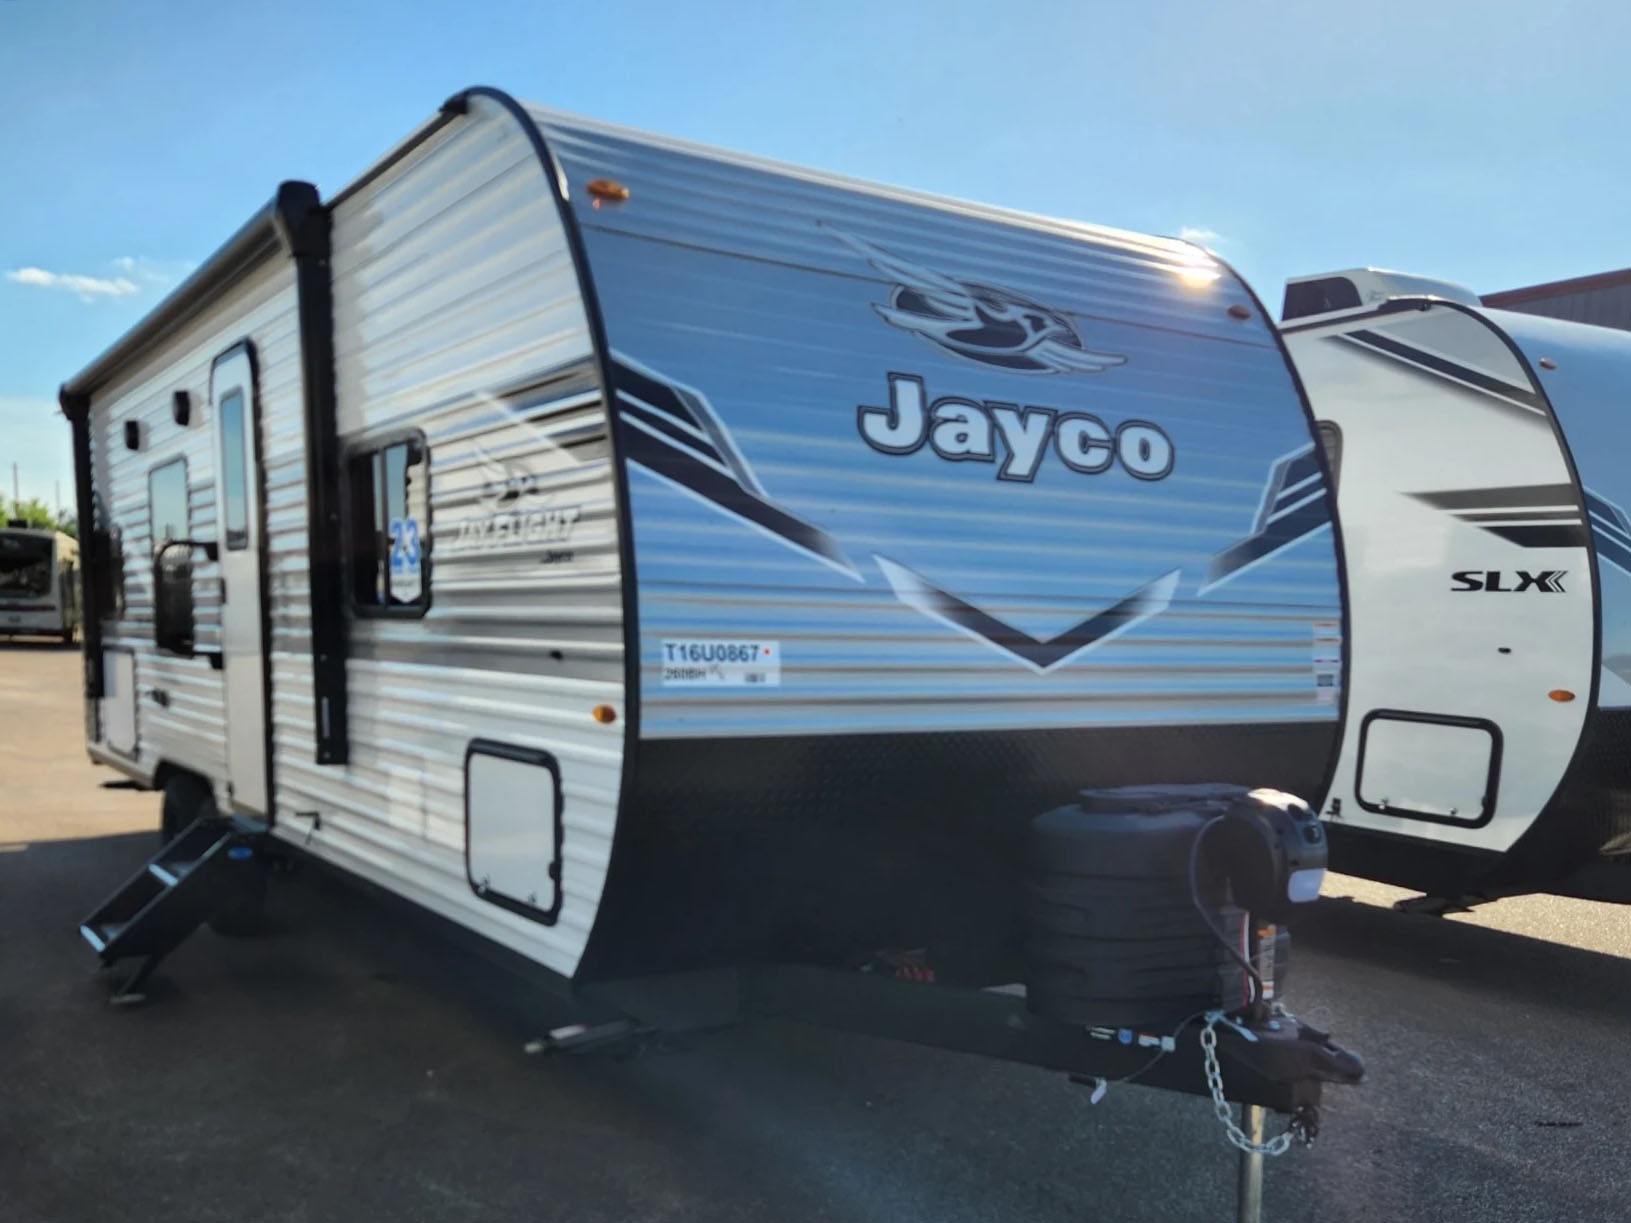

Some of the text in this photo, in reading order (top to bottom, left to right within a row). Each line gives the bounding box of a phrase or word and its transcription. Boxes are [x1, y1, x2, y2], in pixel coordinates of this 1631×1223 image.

[857, 372, 1174, 483] Jayco
[1450, 570, 1567, 593] SLX
[663, 642, 759, 662] T16U0867
